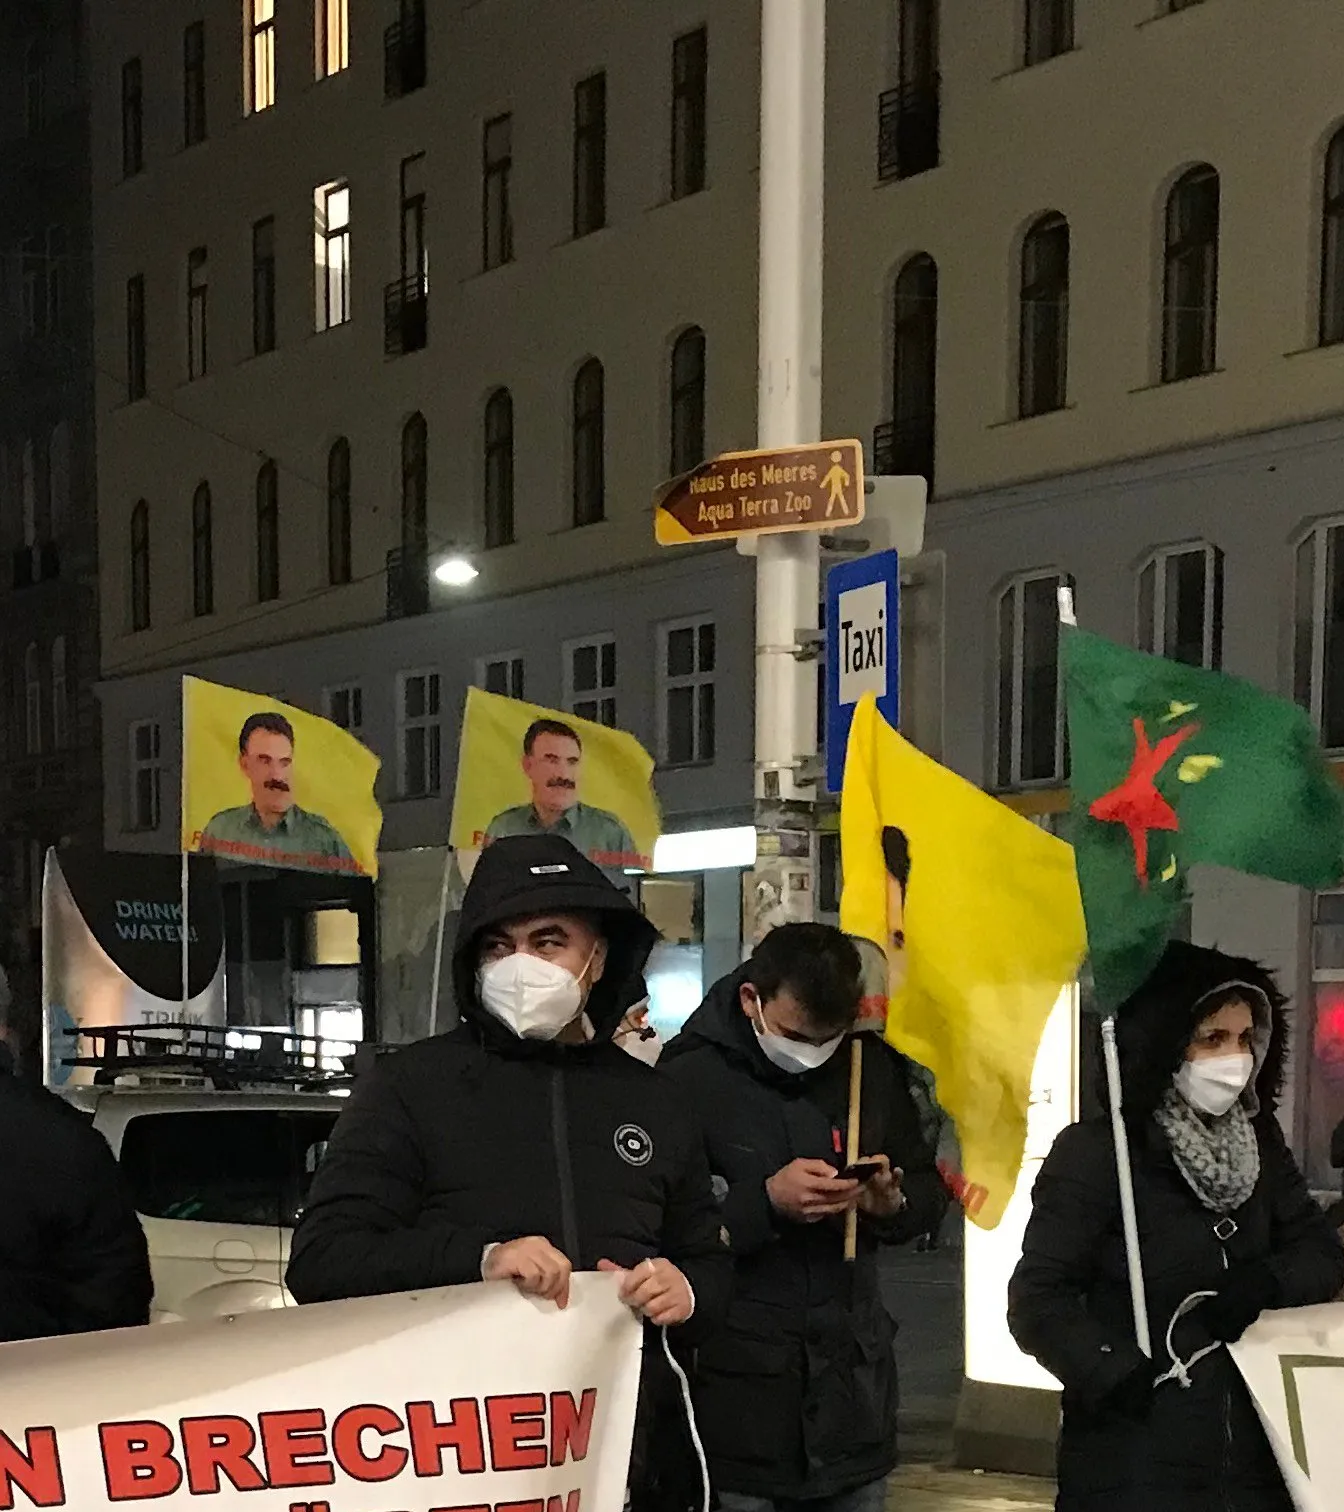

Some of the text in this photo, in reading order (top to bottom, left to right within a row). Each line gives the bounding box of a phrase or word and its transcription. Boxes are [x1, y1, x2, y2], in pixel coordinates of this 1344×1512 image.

[689, 463, 817, 494] Haus des Meeres
[698, 491, 812, 529] Aqua Terra Zoo
[841, 608, 884, 674] Taxi
[115, 900, 183, 920] DRINK
[115, 921, 199, 943] WATE!
[98, 1387, 598, 1503] BRECHEN
